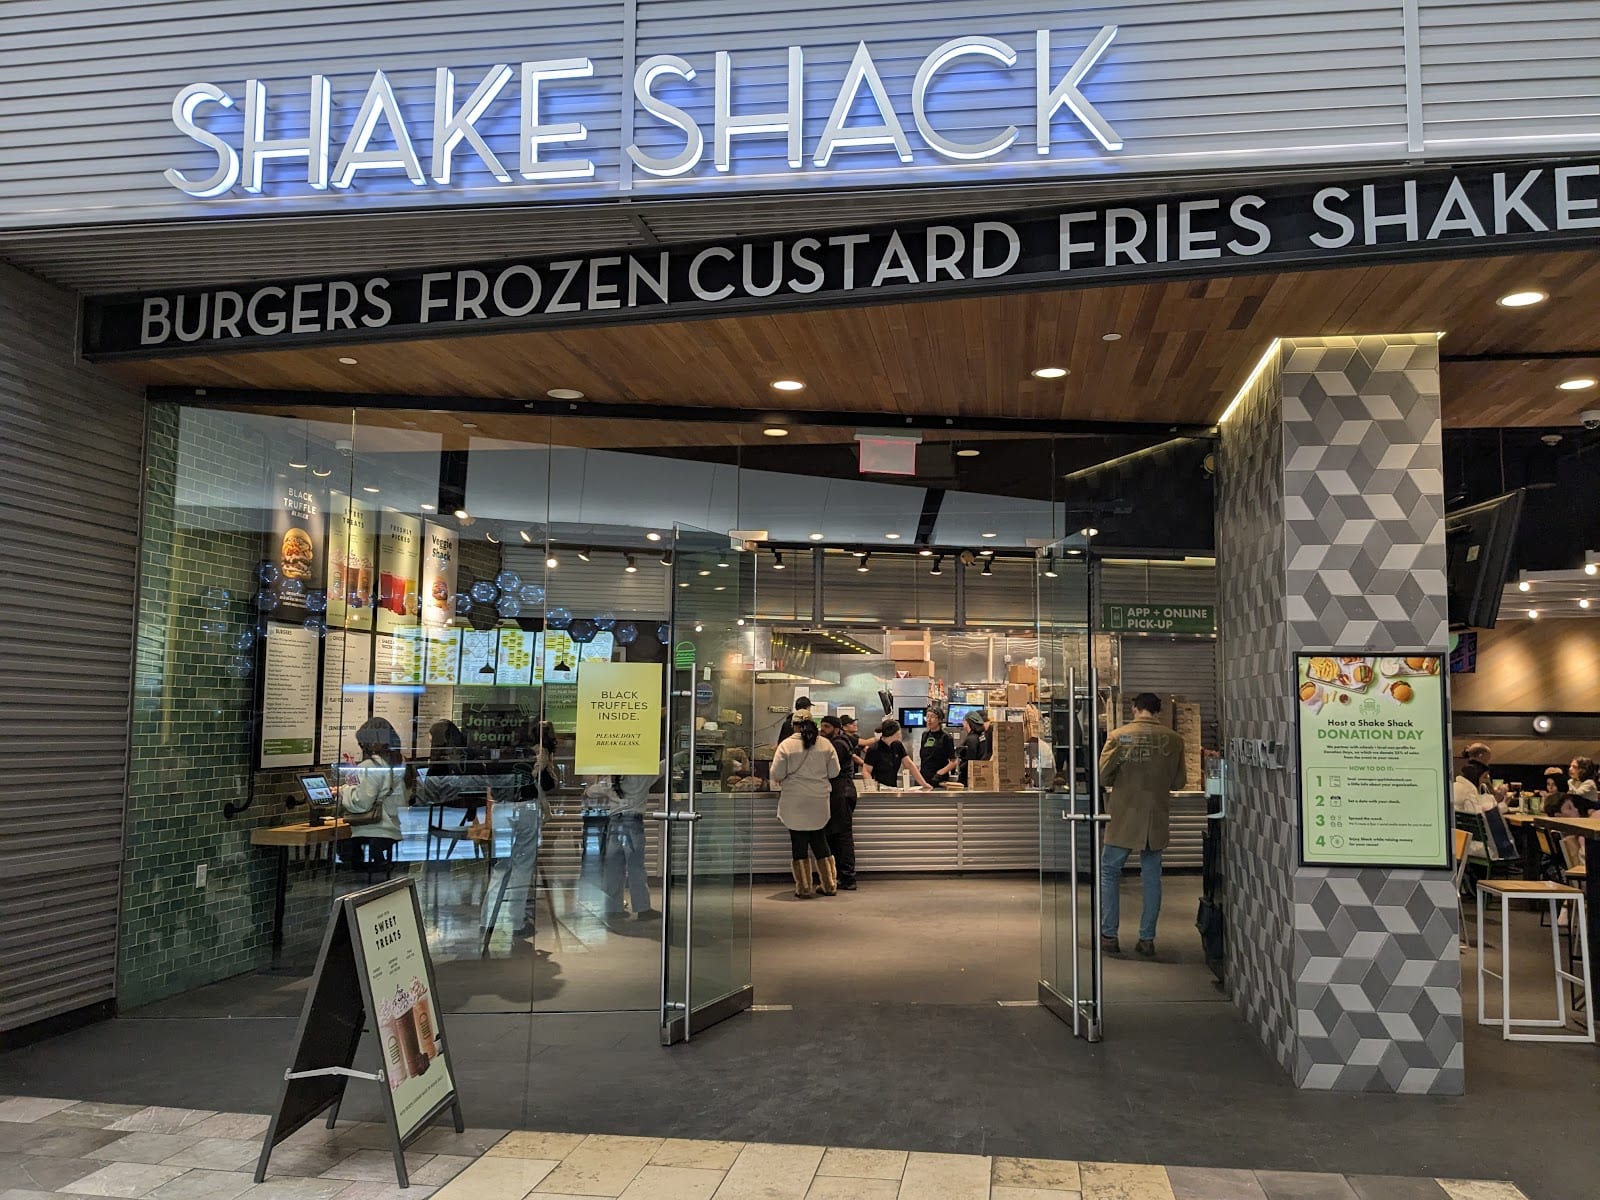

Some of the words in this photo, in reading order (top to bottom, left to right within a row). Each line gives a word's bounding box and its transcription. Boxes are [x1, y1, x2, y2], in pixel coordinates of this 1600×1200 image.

[163, 57, 595, 198] SHAKE
[626, 25, 1124, 176] SHACK
[140, 277, 393, 346] BURGERS
[420, 251, 670, 324] FROZEN
[688, 220, 1021, 303] CUSTARD
[1059, 195, 1272, 272] FRIES
[288, 487, 313, 503] BLACK
[283, 497, 317, 515] TRUFFLE
[432, 534, 452, 550] Veggie
[432, 548, 451, 561] Shack
[1127, 607, 1150, 617] APP
[1163, 608, 1208, 618] ONLINE
[1128, 619, 1174, 629] PICK-UP
[601, 690, 638, 700] BLACK
[590, 702, 648, 710] TRUFFLES
[465, 714, 498, 727] Join
[500, 717, 524, 727] our
[598, 712, 640, 721] INSIDE.
[473, 730, 516, 742] team!
[1318, 729, 1393, 739] DONATION
[1397, 730, 1424, 740] DAY
[1316, 776, 1322, 787] 1
[1315, 795, 1325, 807] 2
[1315, 814, 1325, 826] 3
[1315, 836, 1326, 847] 4
[374, 915, 397, 935] SWEET
[376, 929, 402, 951] TREATS
